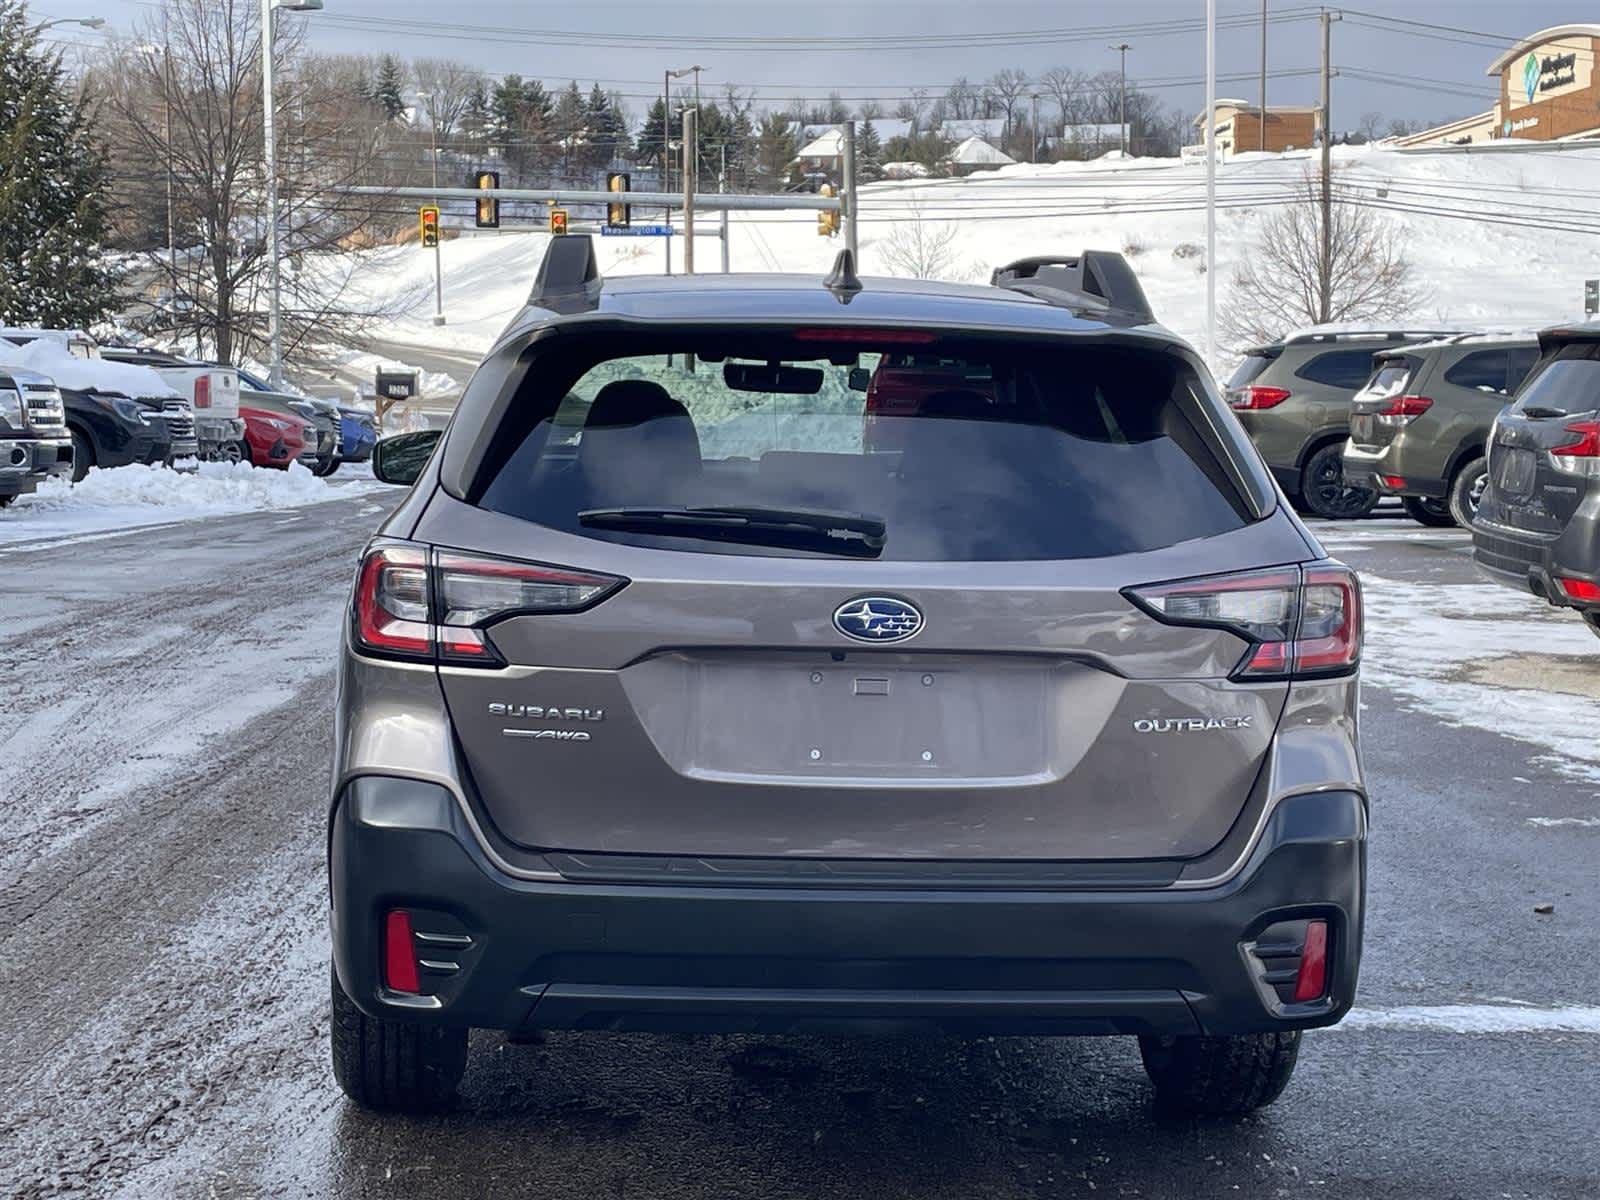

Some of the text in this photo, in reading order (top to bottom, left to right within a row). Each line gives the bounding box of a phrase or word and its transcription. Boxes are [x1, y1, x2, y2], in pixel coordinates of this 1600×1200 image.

[488, 702, 603, 721] SUBARU
[1133, 716, 1253, 733] OUTBACK
[535, 729, 591, 741] AWD
